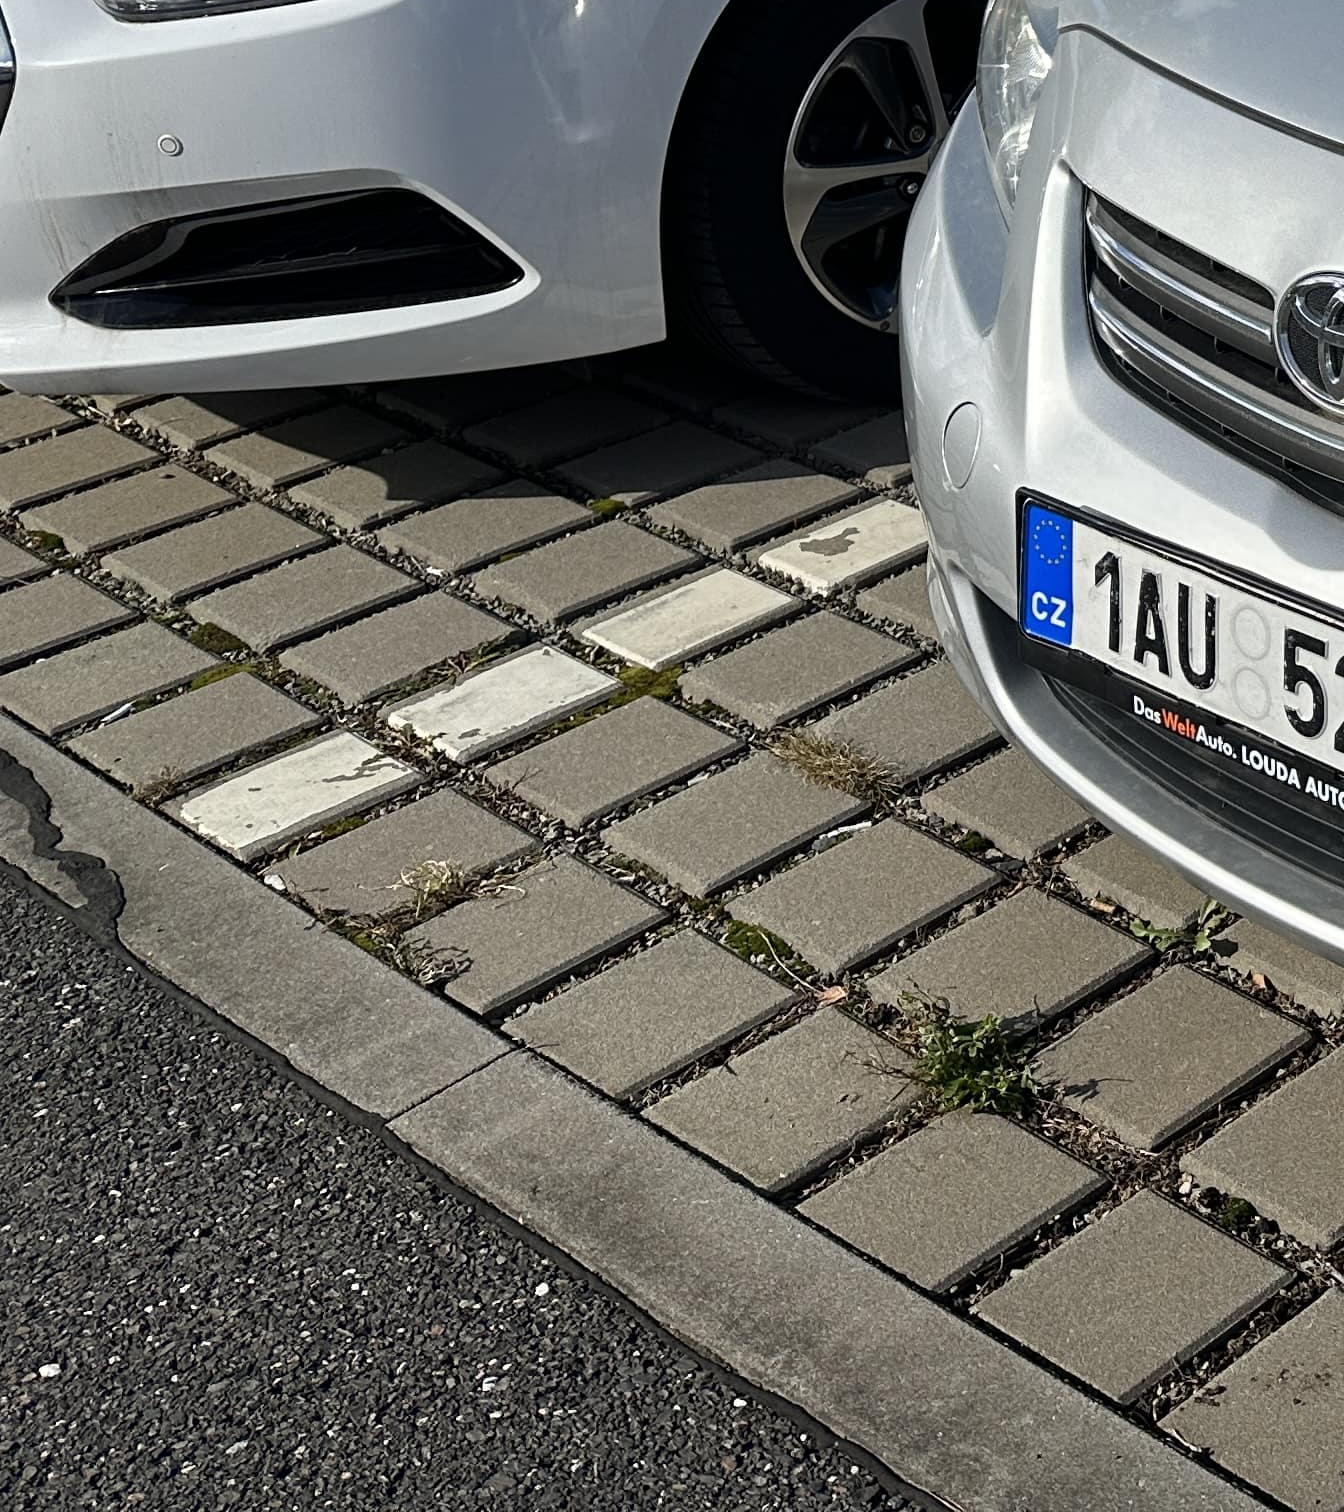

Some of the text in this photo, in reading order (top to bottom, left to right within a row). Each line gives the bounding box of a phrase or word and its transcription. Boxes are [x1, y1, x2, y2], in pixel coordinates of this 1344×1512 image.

[1031, 590, 1067, 629] CZ
[1094, 550, 1219, 691] 1AU
[1241, 745, 1301, 790] LOUDA
